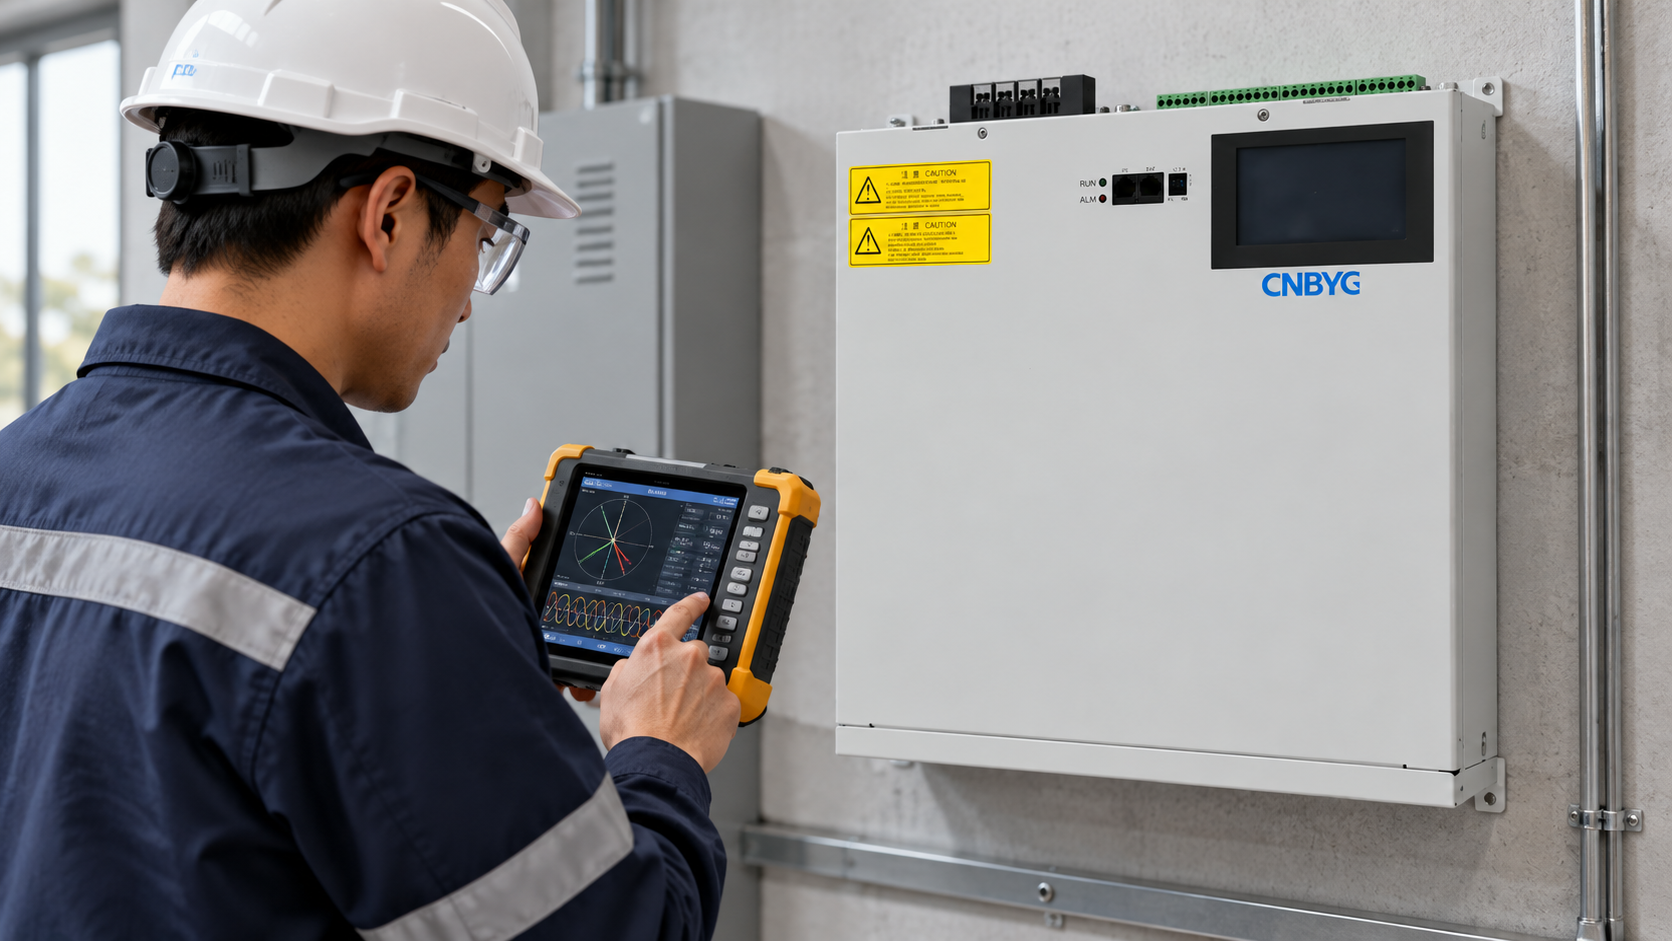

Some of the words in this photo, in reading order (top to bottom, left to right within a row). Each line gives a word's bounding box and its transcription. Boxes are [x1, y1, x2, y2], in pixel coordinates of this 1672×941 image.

[925, 169, 957, 177] CAUTION
[925, 221, 957, 229] CAUTION
[1261, 270, 1360, 297] CNBYG
